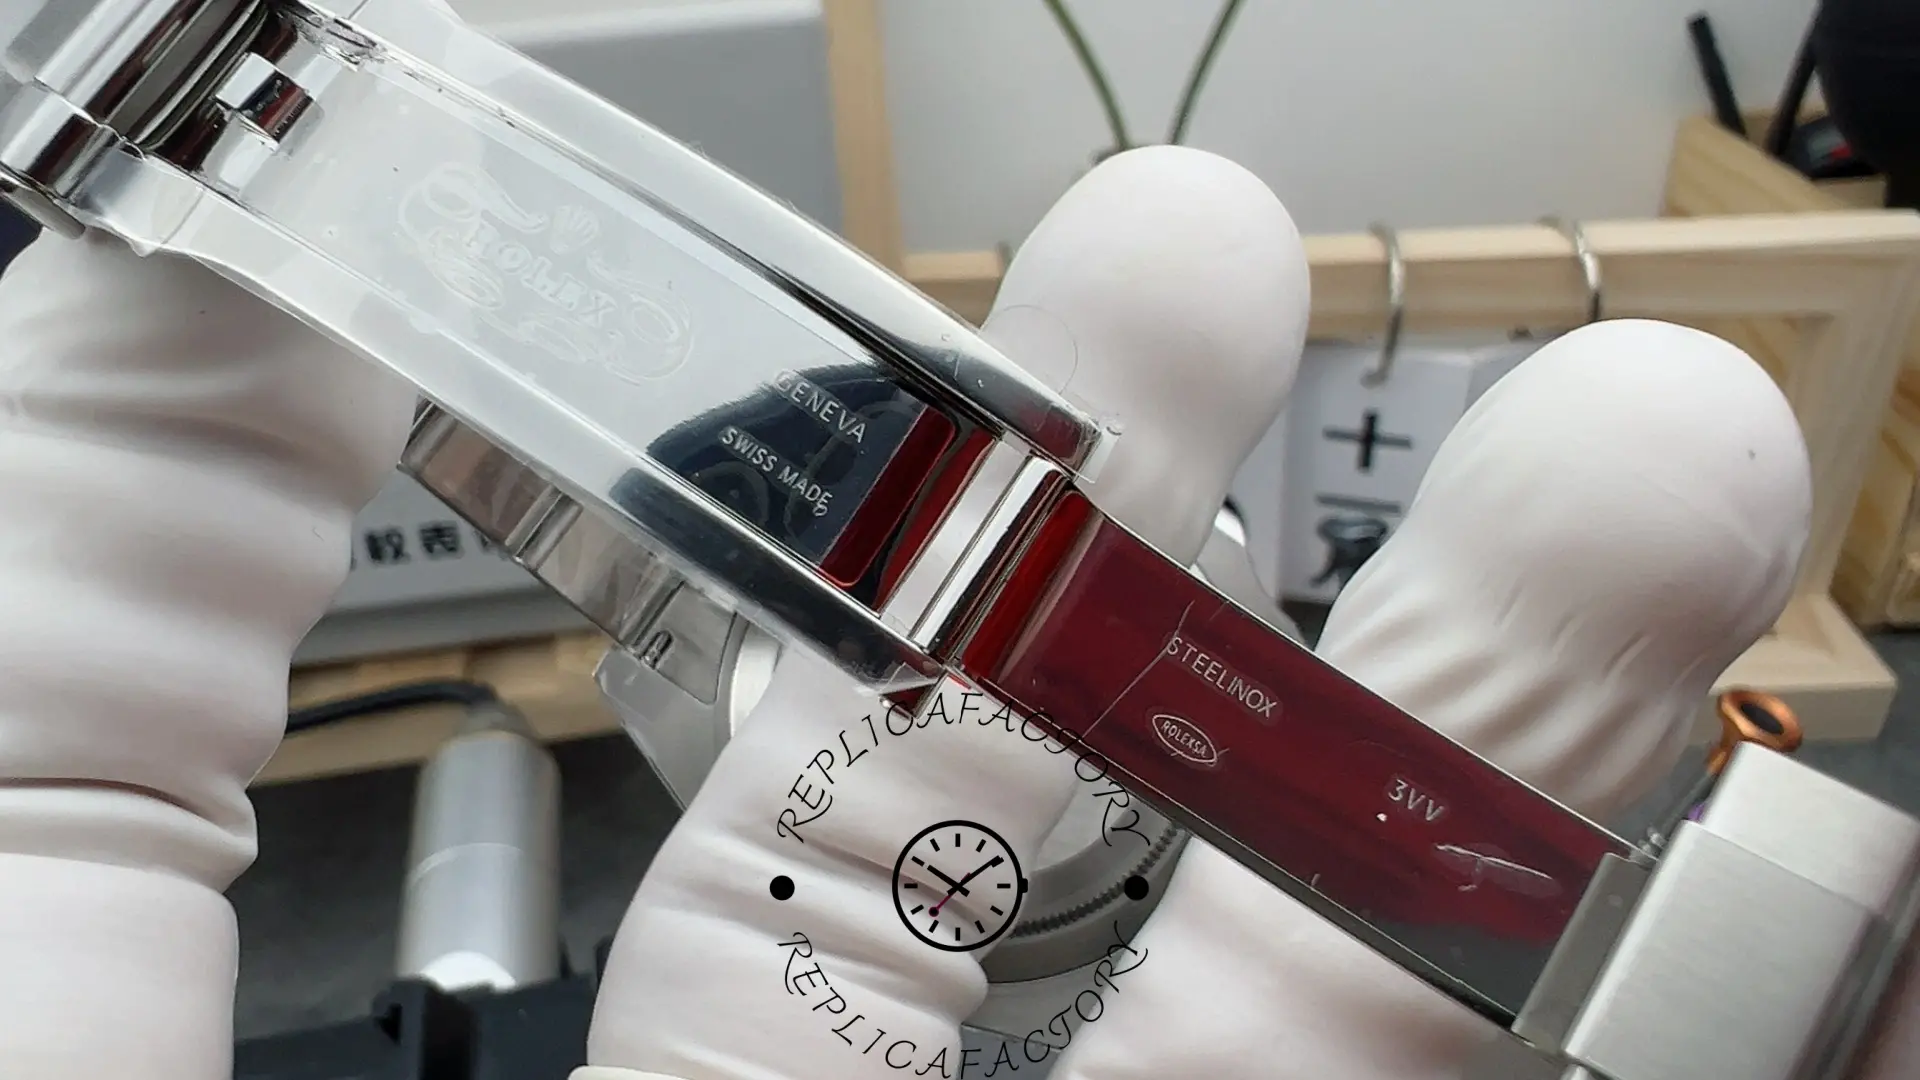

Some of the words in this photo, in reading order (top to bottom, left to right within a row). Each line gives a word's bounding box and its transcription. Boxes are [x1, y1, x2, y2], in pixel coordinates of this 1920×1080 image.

[774, 369, 867, 444] GENEVA
[721, 426, 779, 473] SWISS
[776, 464, 834, 508] MADE
[1166, 636, 1278, 718] STEELINOX
[1387, 778, 1445, 821] 3VV
